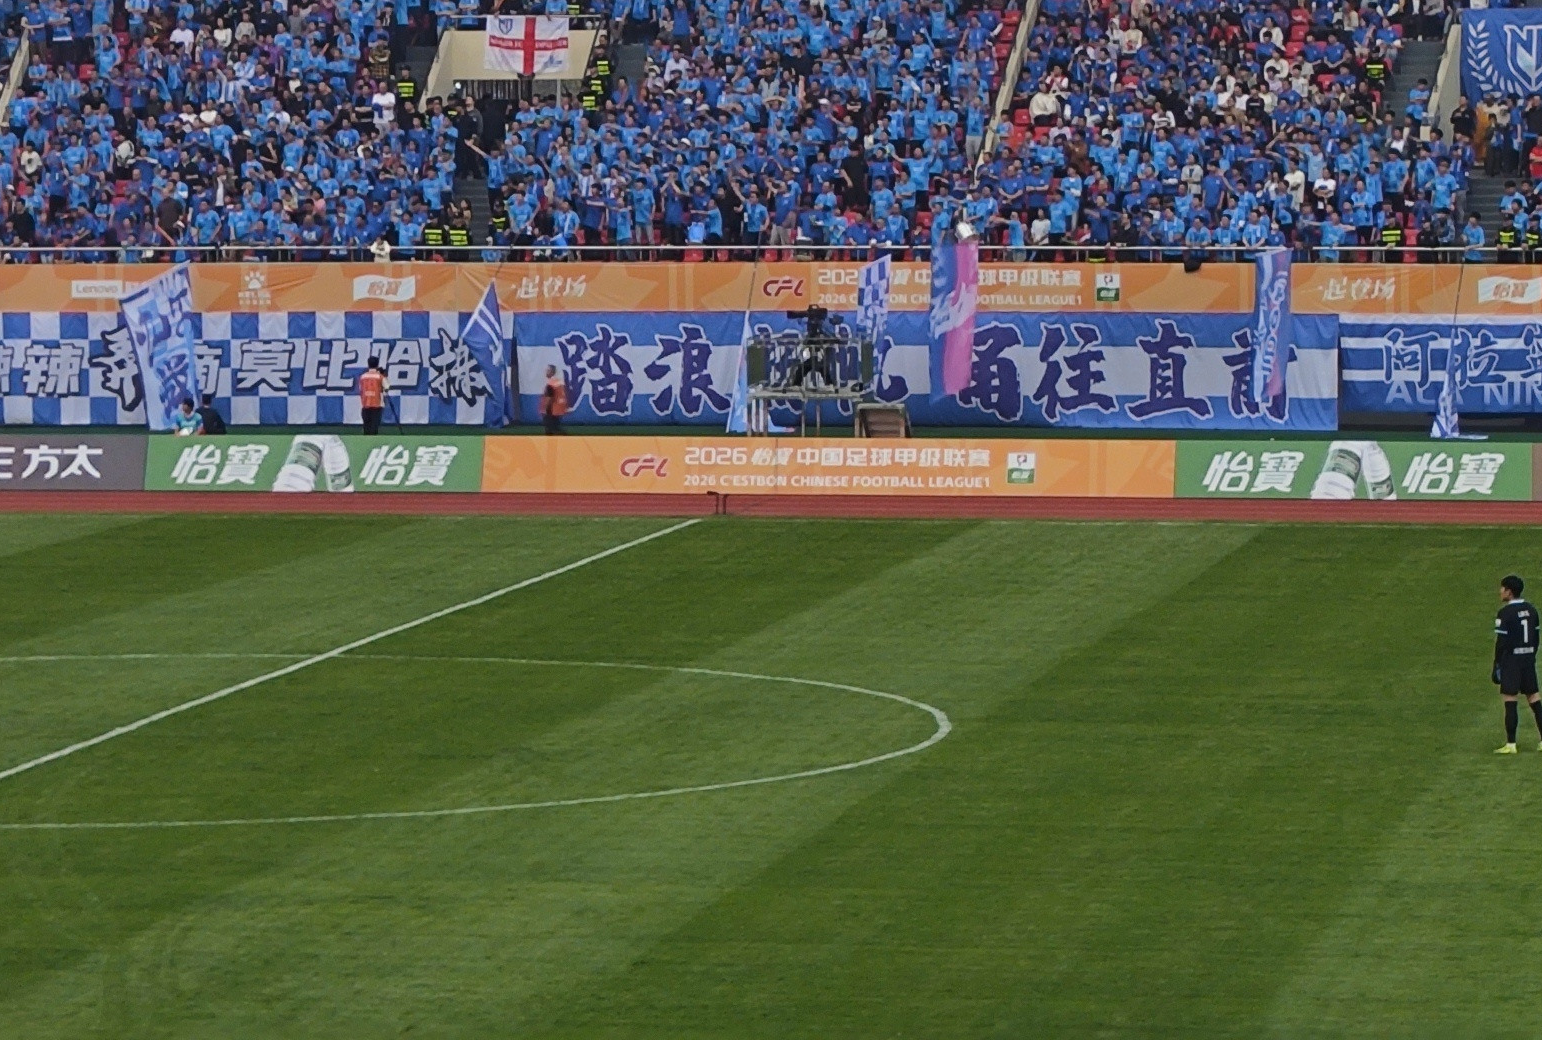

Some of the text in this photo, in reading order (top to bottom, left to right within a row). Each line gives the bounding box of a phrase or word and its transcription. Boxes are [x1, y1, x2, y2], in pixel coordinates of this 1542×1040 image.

[20, 443, 104, 480] 方太
[683, 446, 748, 466] 2026
[683, 474, 717, 487] 2026
[790, 474, 849, 488] CHINESE
[852, 475, 925, 488] FOOTBALL
[1520, 618, 1529, 644] 1
